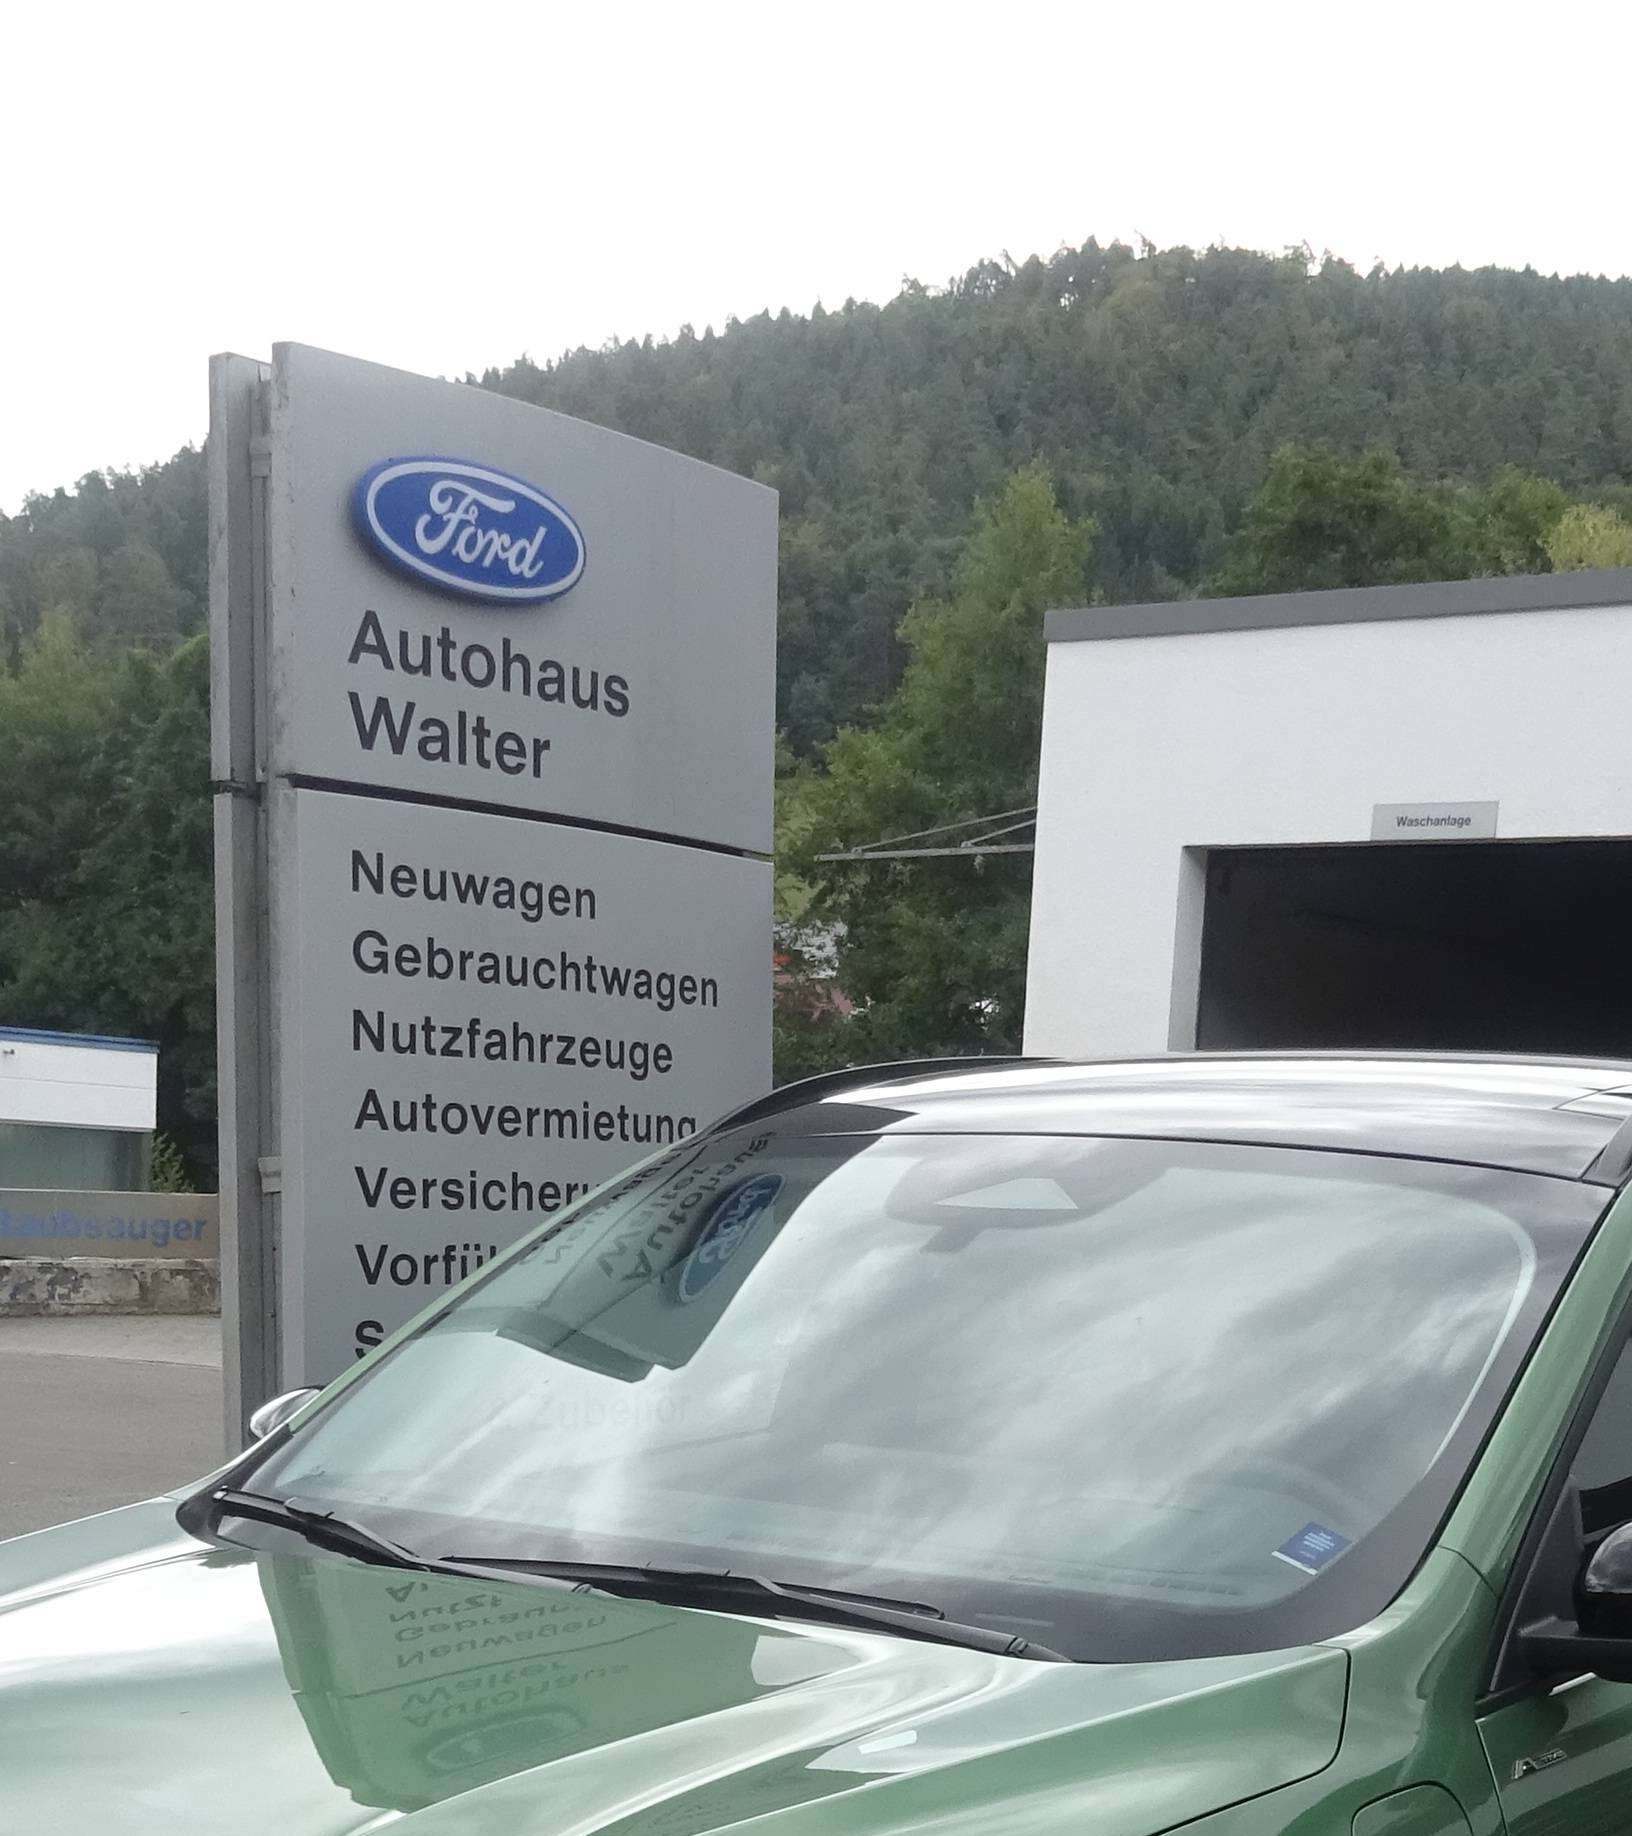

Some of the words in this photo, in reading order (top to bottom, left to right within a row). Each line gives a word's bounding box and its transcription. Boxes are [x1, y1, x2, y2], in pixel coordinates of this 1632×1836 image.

[415, 479, 547, 579] Ford
[348, 610, 630, 718] Autohaus
[348, 691, 550, 778] Walter
[1396, 815, 1471, 828] Waschanlage
[351, 849, 597, 922] Neuwagen
[352, 929, 718, 1012] Gebrauchtwagen
[352, 1009, 673, 1080] Nutzfahrzeuge
[355, 1167, 601, 1212] Versicher
[355, 1243, 497, 1286] Vorfü
